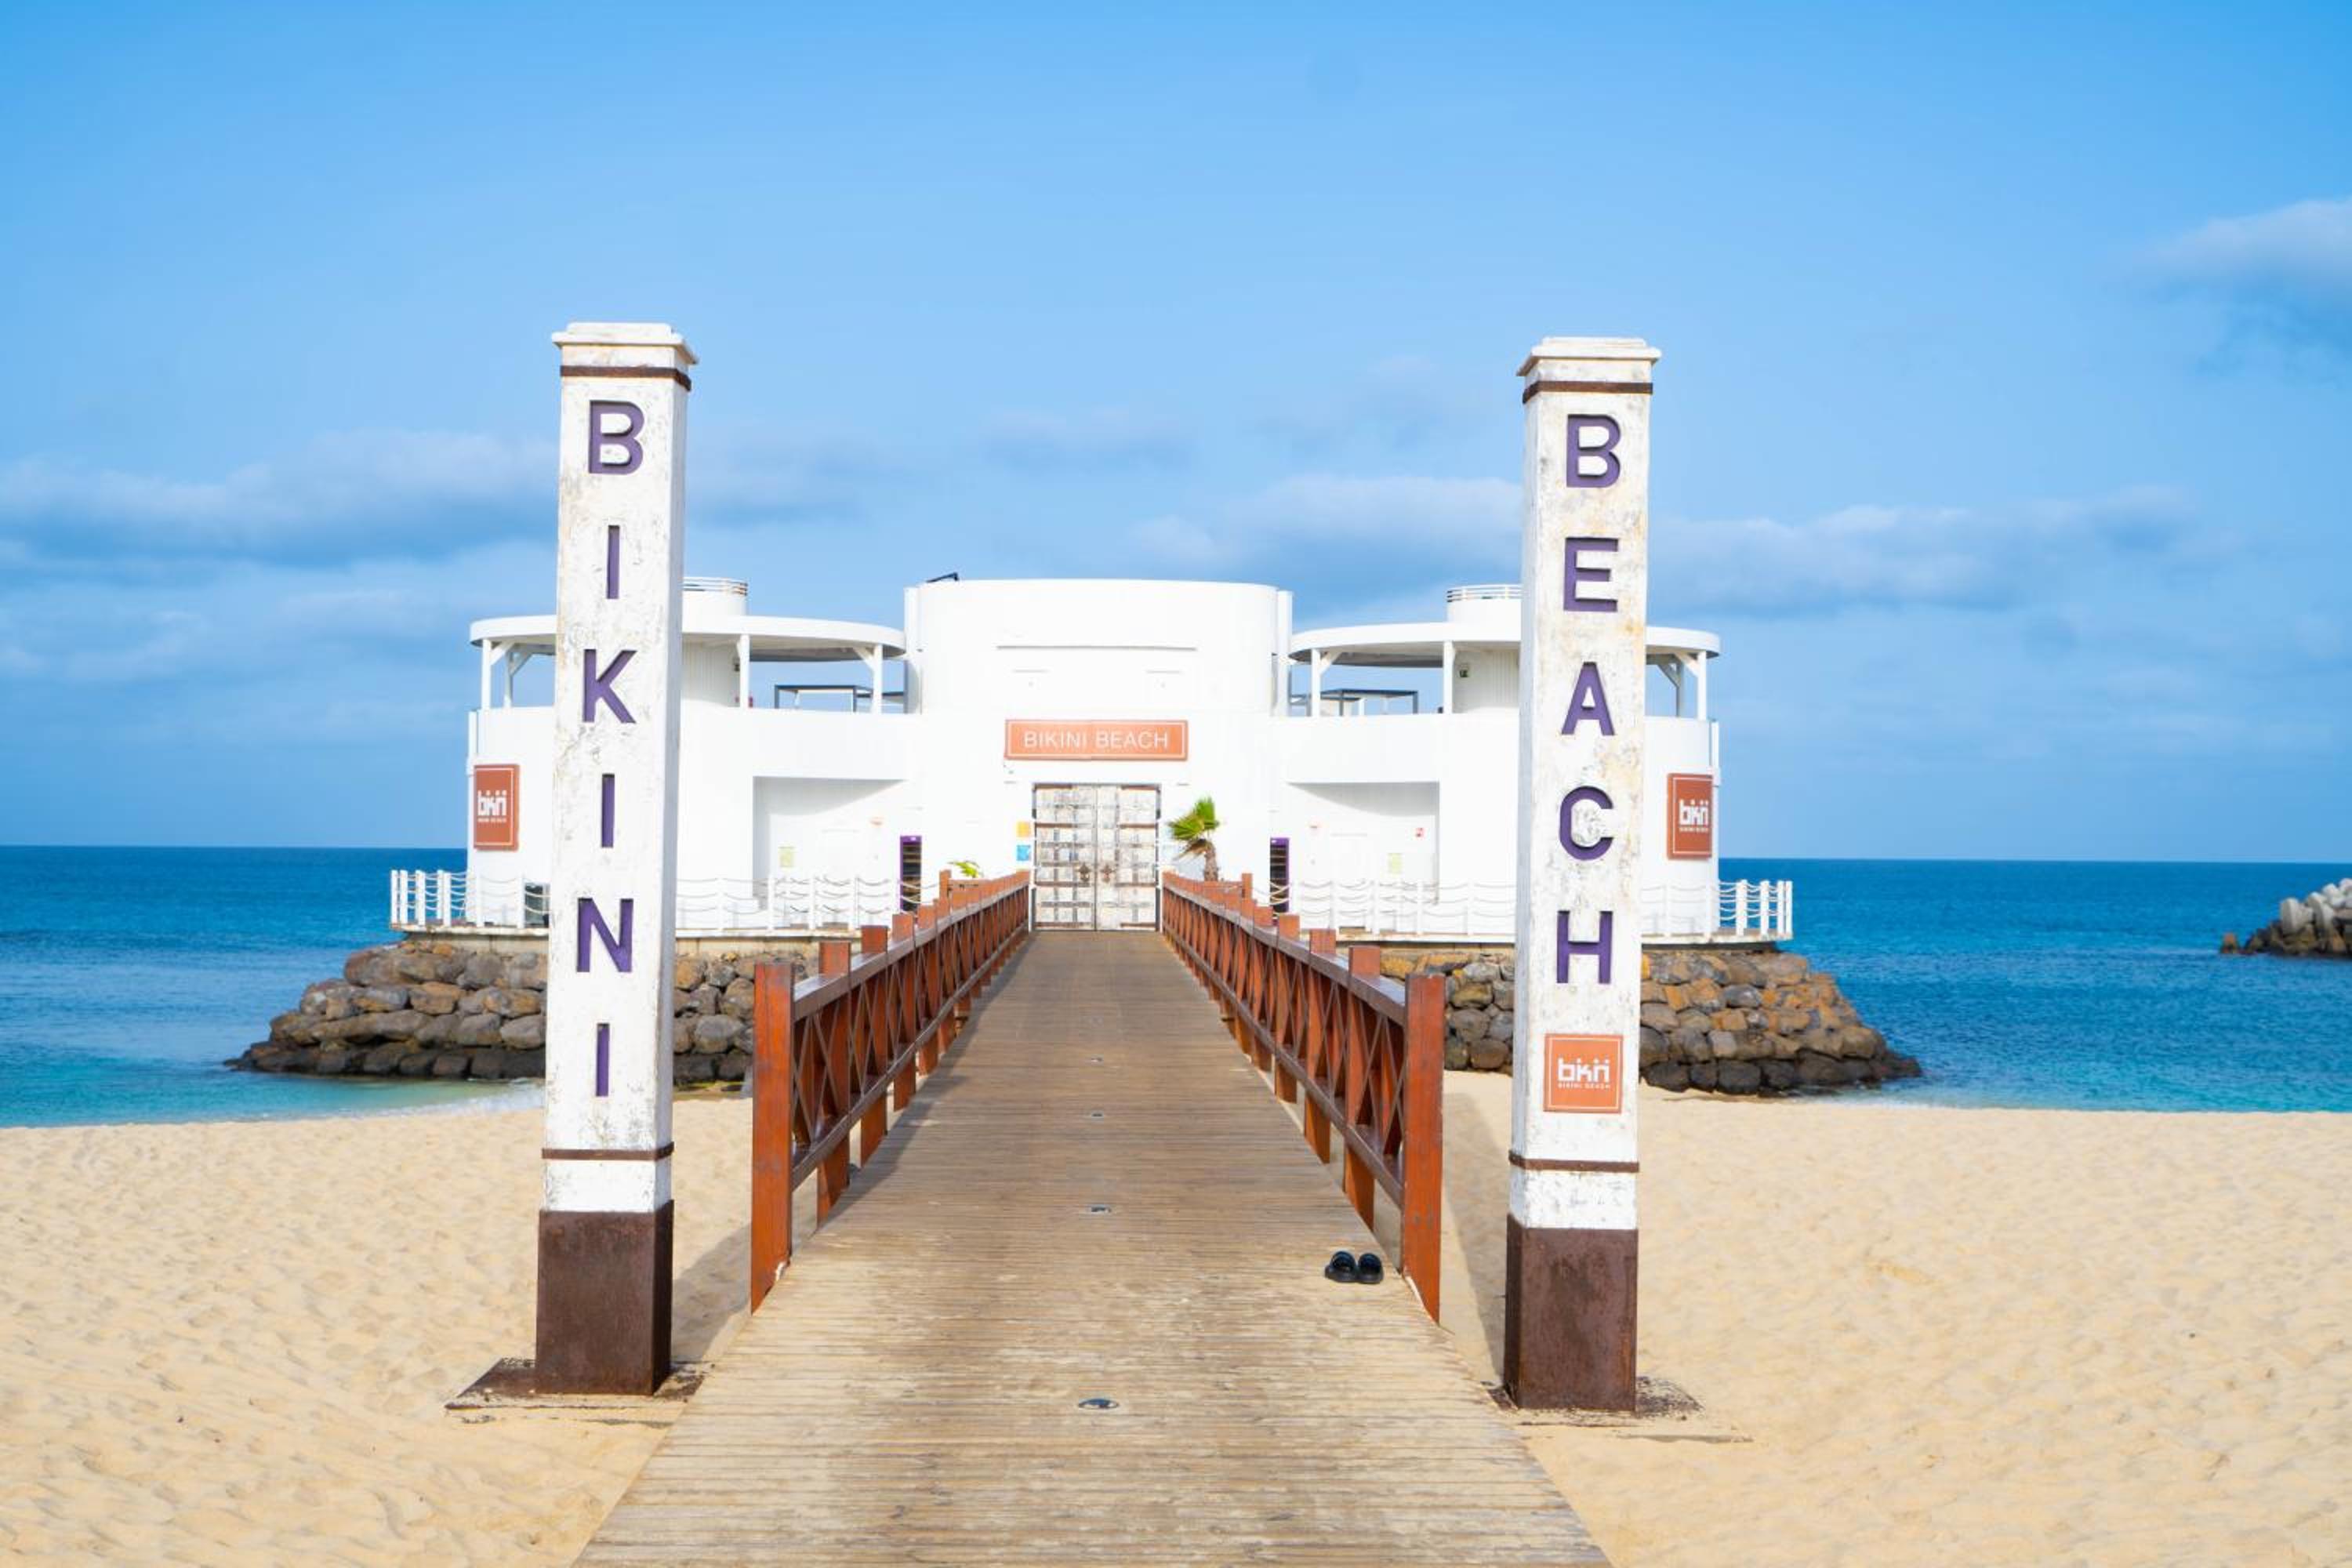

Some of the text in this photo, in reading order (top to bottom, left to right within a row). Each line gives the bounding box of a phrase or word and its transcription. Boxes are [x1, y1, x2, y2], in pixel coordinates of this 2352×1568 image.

[577, 400, 644, 1096] BIKINI
[1024, 730, 1168, 750] BIKINI BEACH
[1556, 413, 1621, 984] BEACH
